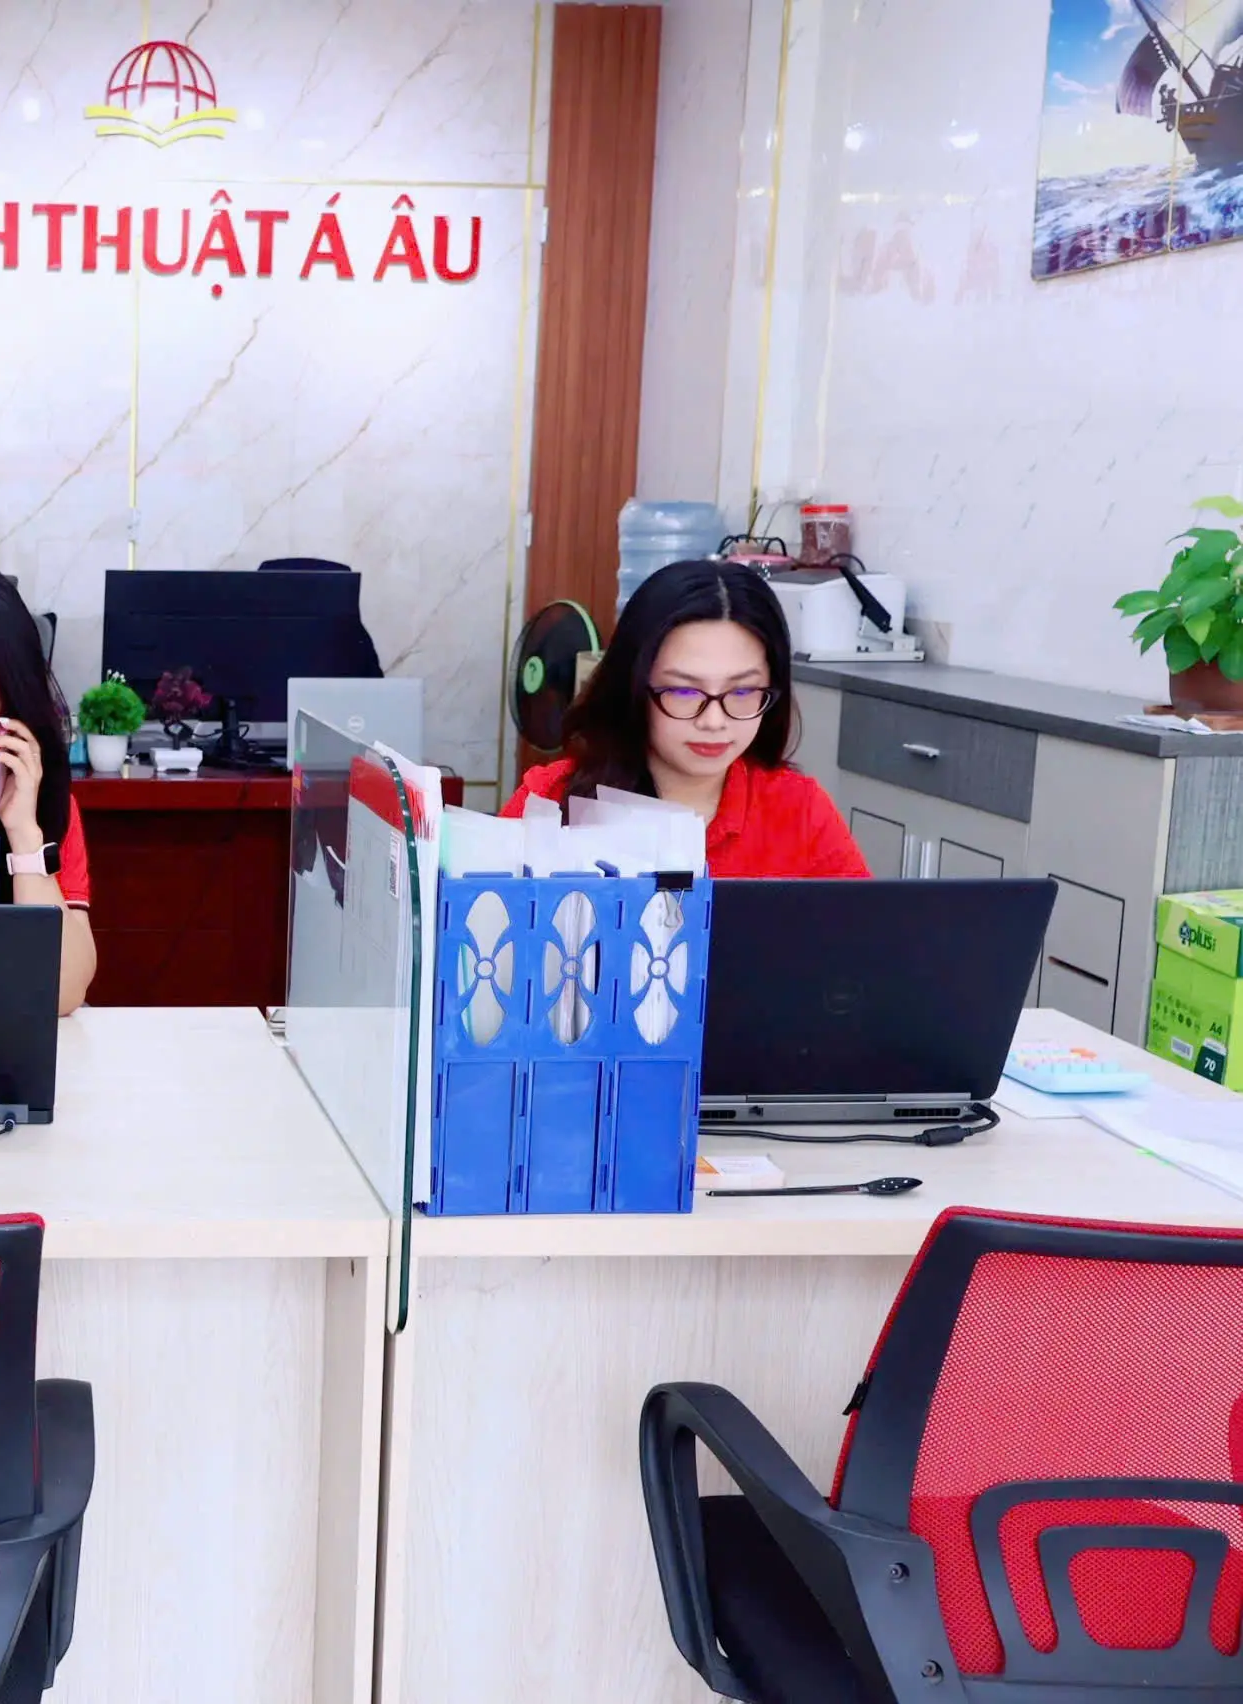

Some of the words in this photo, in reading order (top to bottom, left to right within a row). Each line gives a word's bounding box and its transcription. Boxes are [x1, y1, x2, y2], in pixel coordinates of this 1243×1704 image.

[32, 188, 290, 298] THUẬT
[300, 192, 355, 280] Á
[372, 193, 482, 283] ÂU
[1209, 1022, 1223, 1035] A4
[1204, 1057, 1217, 1072] 70
